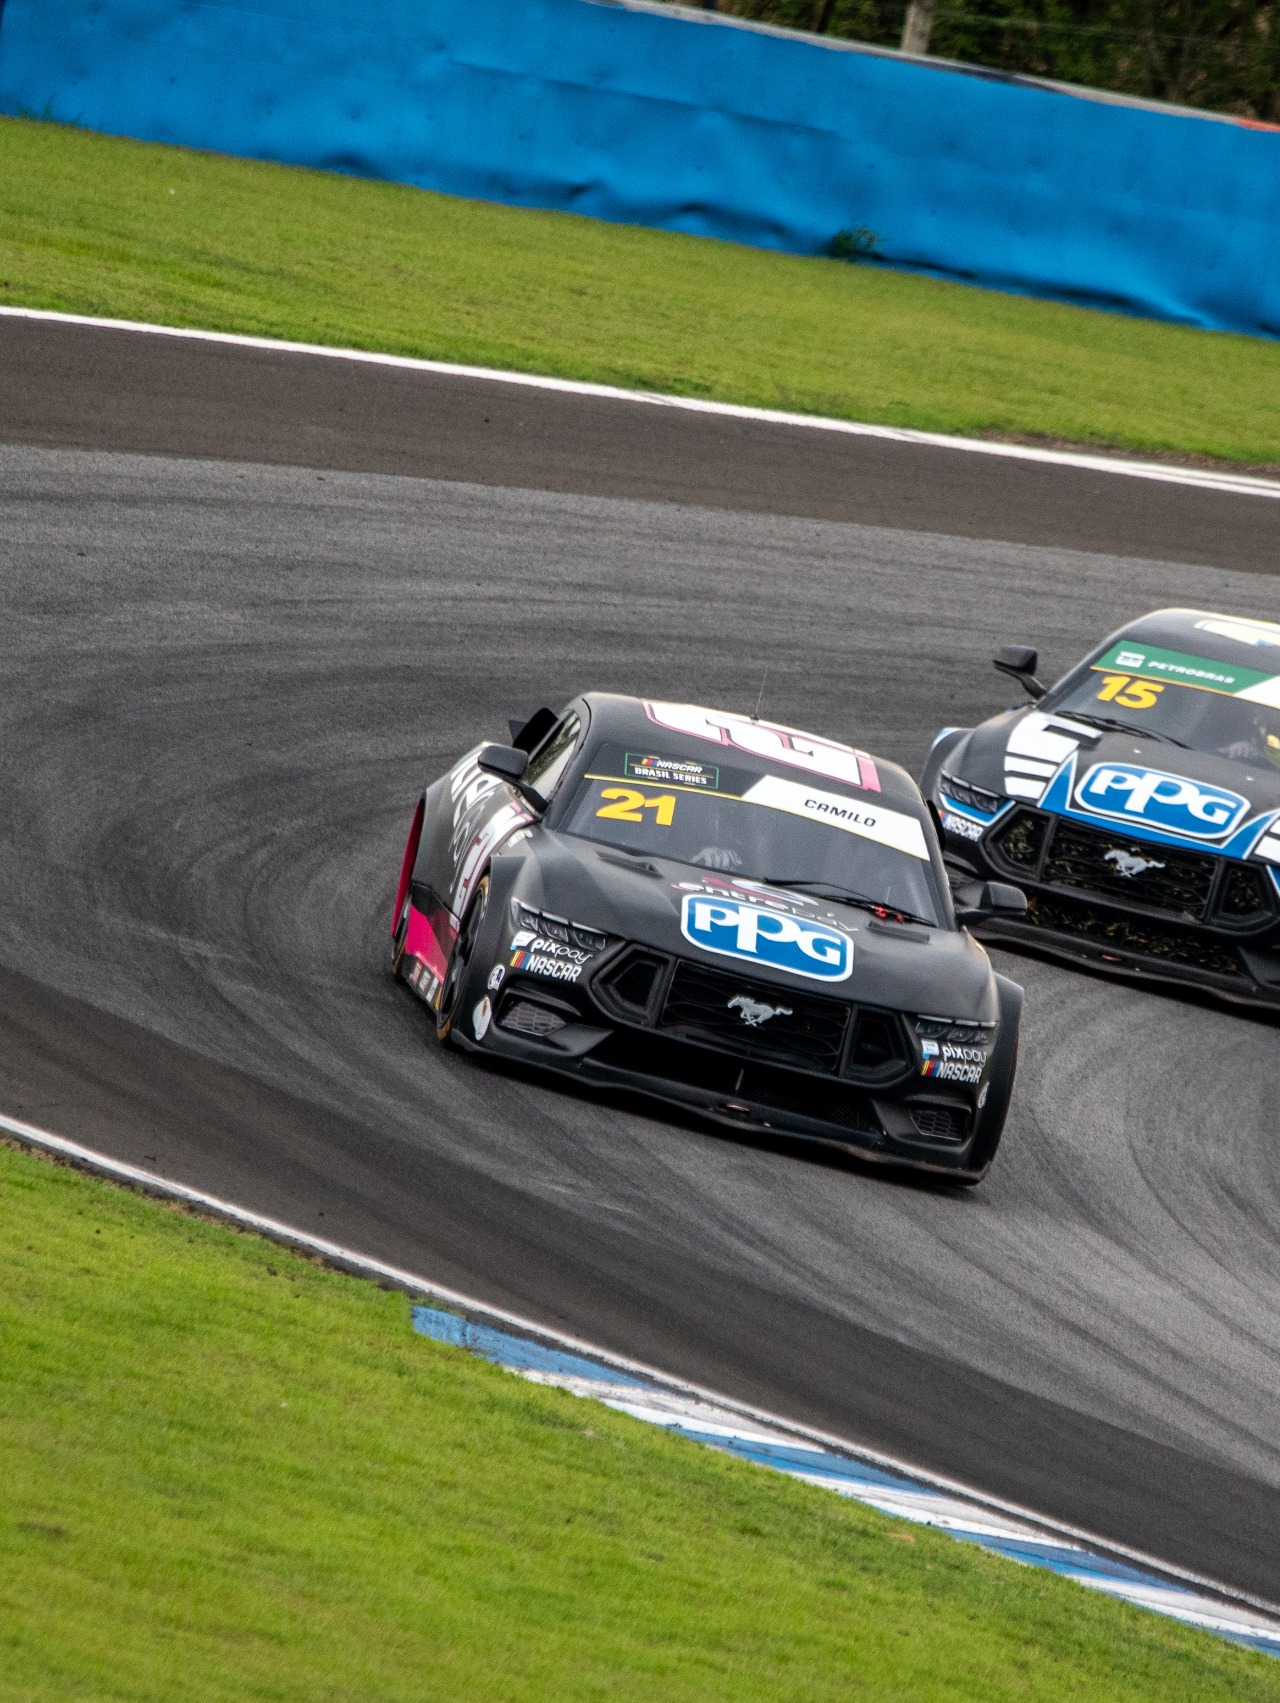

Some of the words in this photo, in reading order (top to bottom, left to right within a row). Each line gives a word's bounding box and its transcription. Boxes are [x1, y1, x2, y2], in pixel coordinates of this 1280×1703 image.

[1148, 660, 1236, 684] PETROBRAS
[1095, 675, 1165, 709] 15
[634, 767, 670, 779] BRASIL
[673, 772, 707, 785] SERIES
[656, 760, 703, 773] NASCAR
[596, 787, 676, 826] 21
[1089, 769, 1238, 826] PPG
[803, 799, 877, 828] CAMILO
[694, 902, 841, 966] PPG
[530, 939, 594, 965] pixpay
[525, 955, 583, 983] NASCAR
[941, 1042, 987, 1068] pixpay
[936, 1061, 983, 1084] NASCAR
